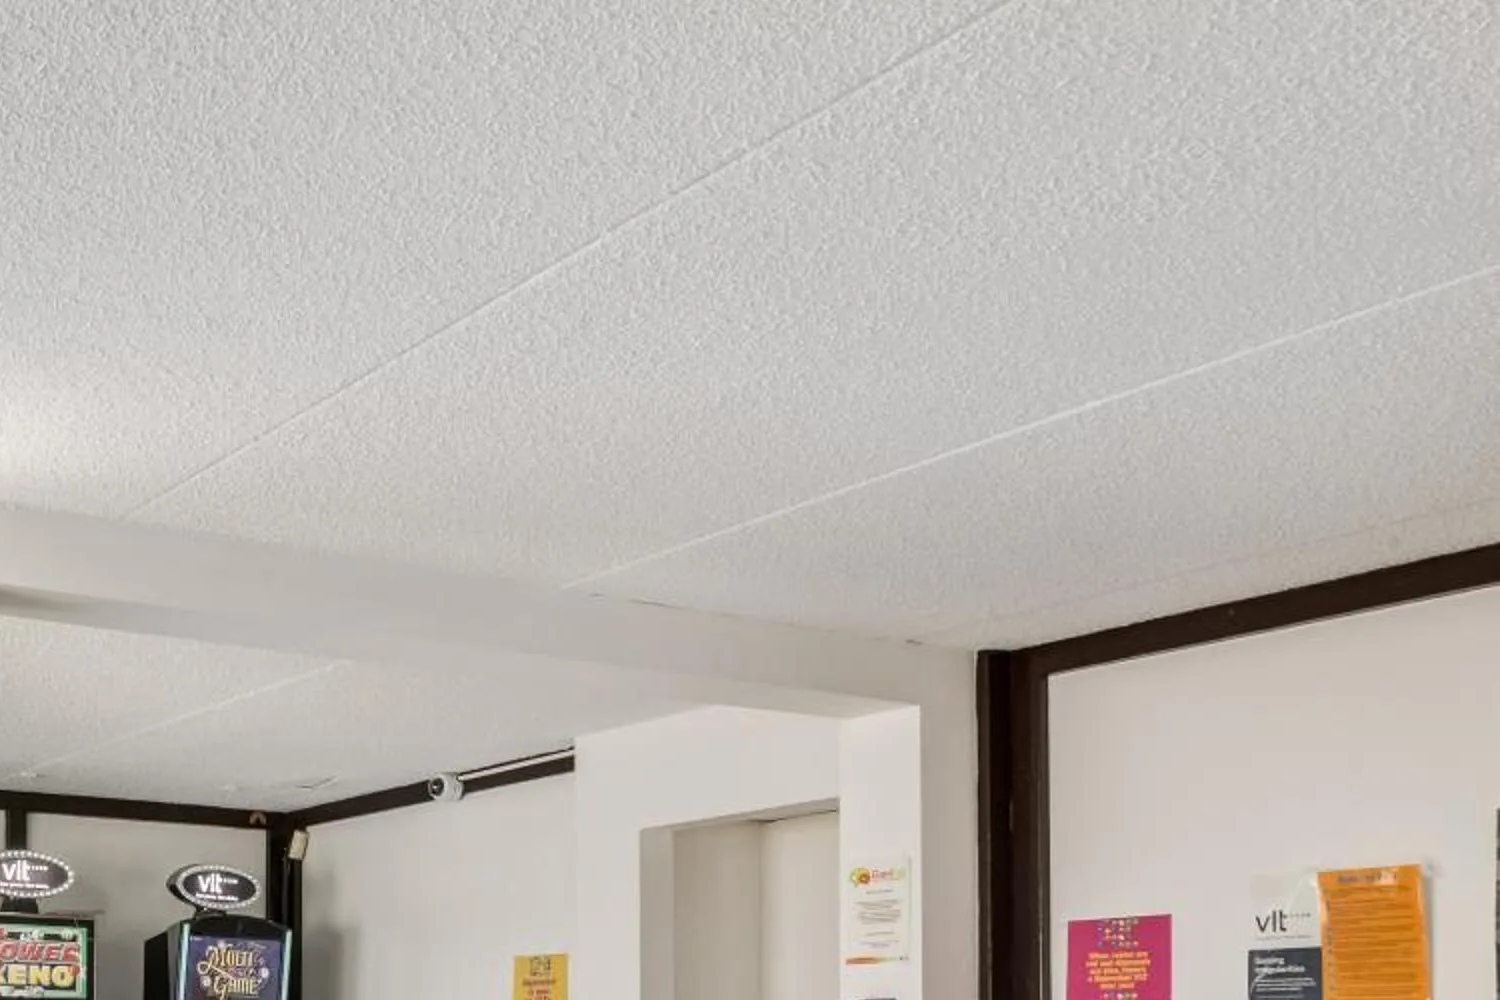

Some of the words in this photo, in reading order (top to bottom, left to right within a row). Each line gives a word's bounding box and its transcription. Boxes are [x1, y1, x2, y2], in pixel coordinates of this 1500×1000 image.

[2, 860, 31, 881] vlt
[197, 873, 223, 894] vlt
[1255, 909, 1288, 932] vlt
